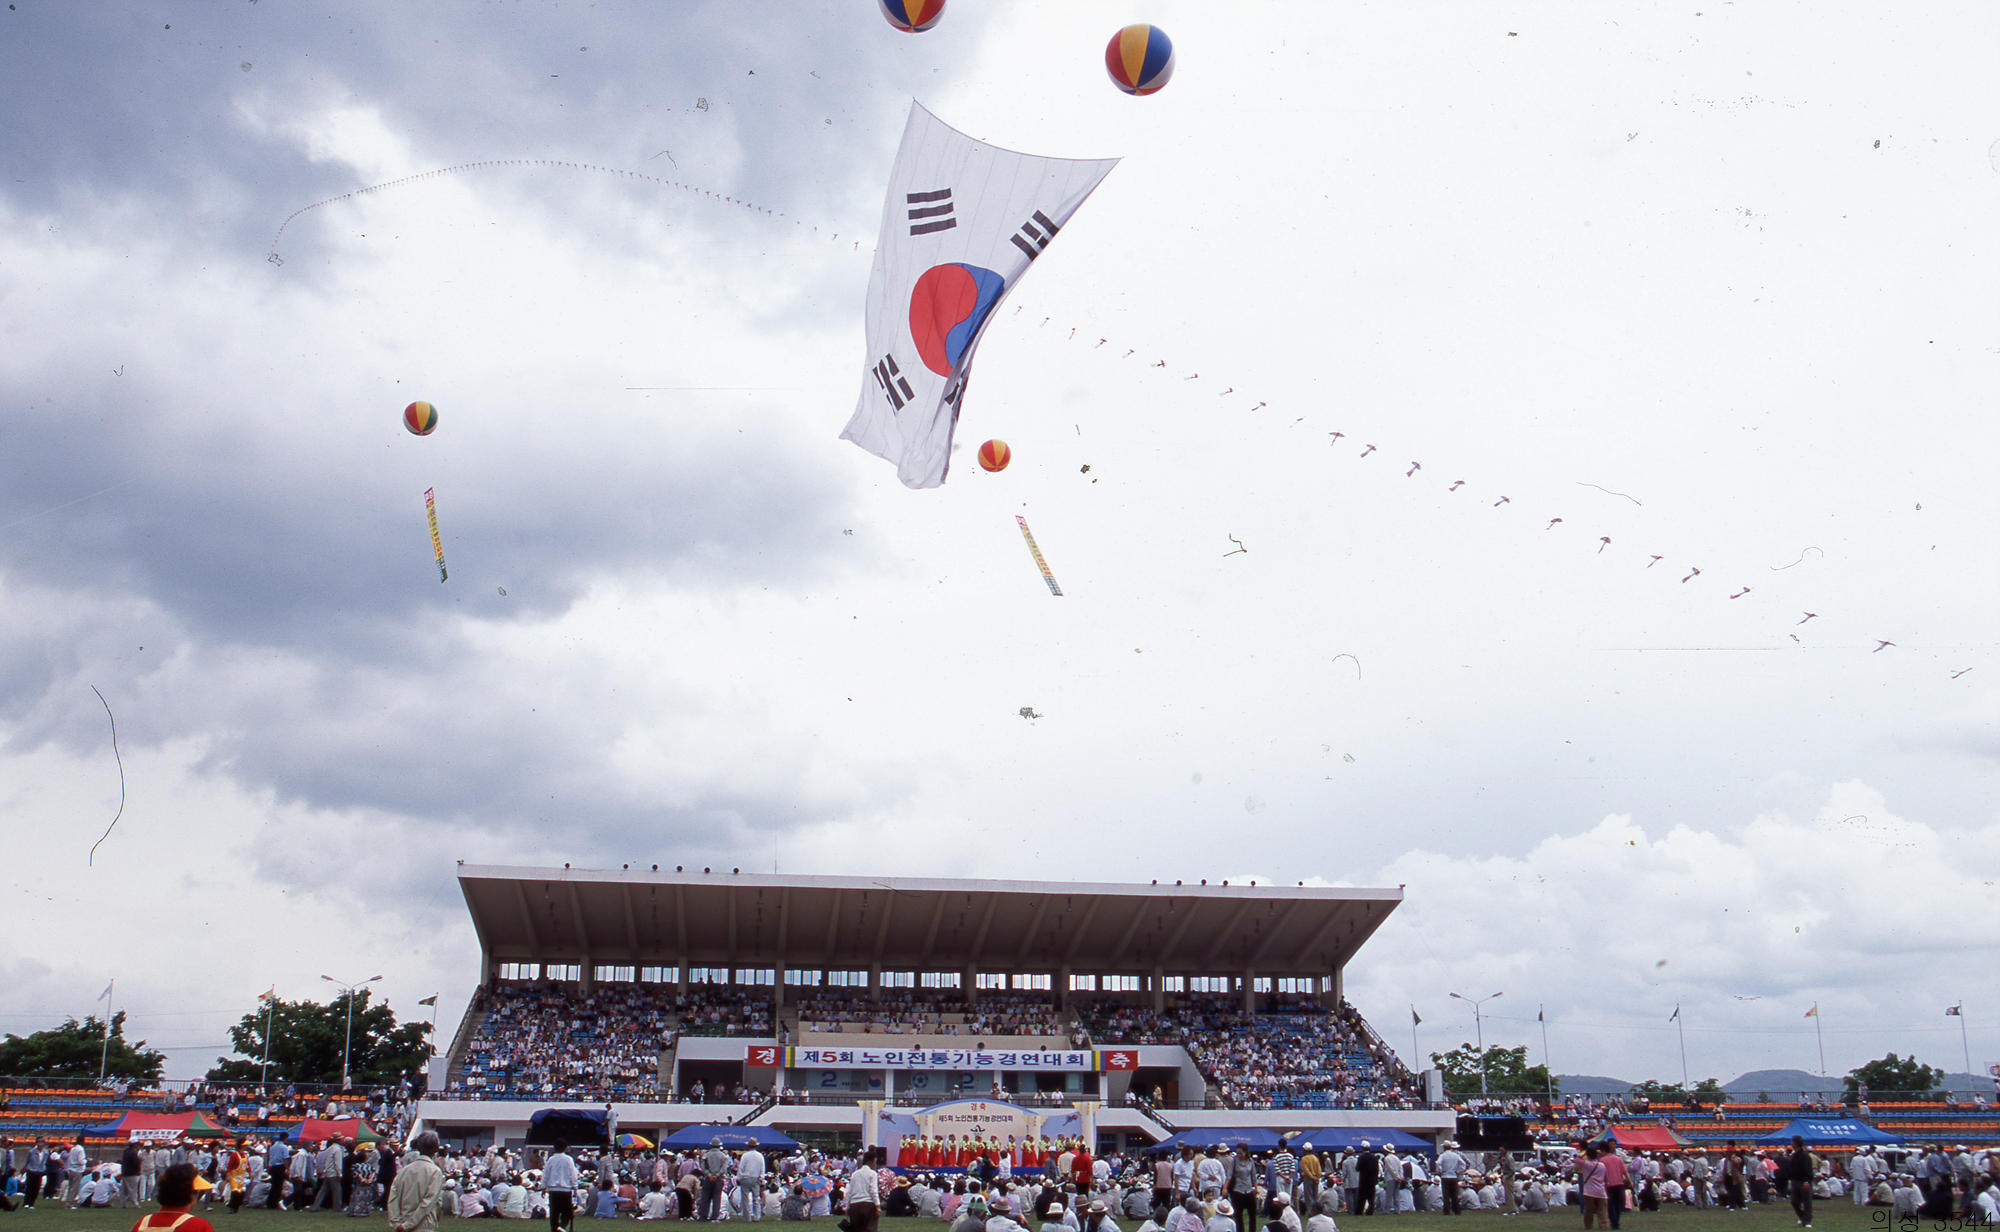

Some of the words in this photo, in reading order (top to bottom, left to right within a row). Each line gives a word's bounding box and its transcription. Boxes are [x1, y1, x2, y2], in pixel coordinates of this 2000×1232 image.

[755, 1048, 775, 1064] 경
[803, 1050, 854, 1064] 제5회
[860, 1051, 1084, 1067] 노인전통기능경연대회
[1109, 1052, 1131, 1068] 축
[938, 1114, 954, 1122] 제5회
[955, 1114, 1014, 1122] 노인전통기능경연대회
